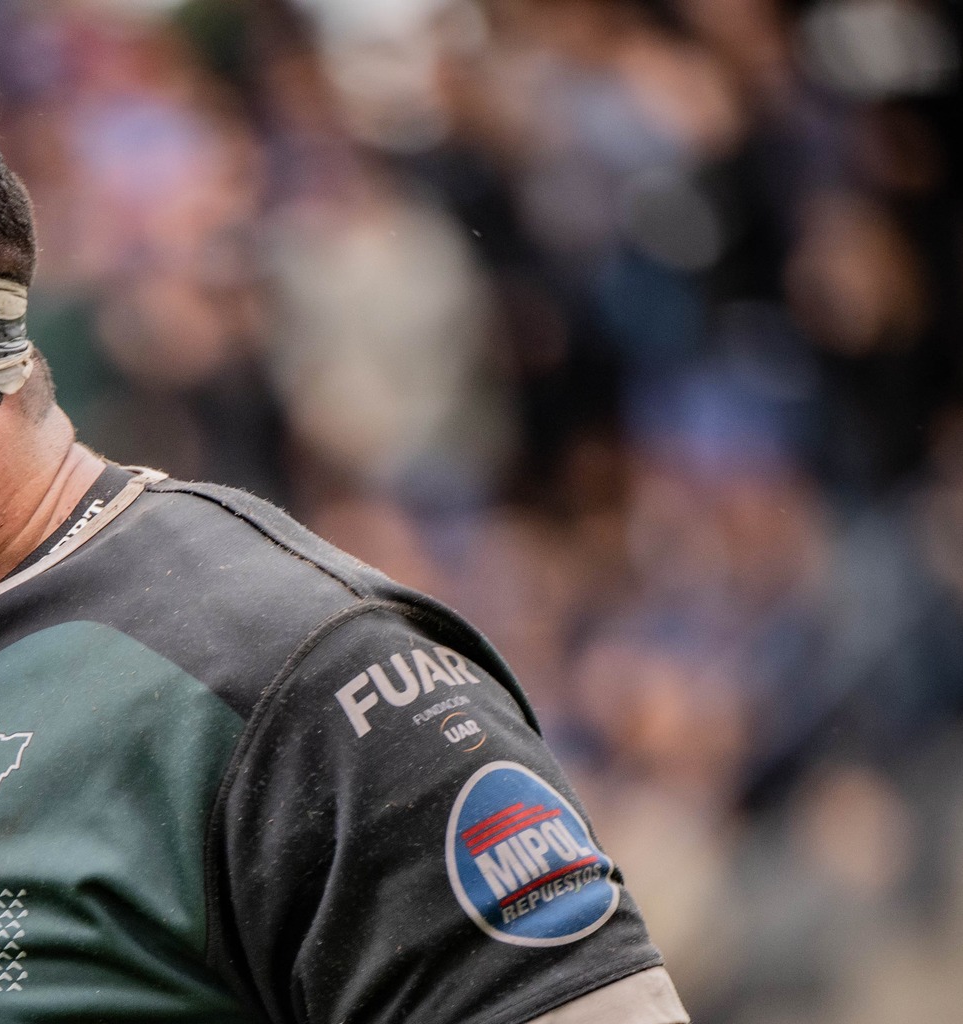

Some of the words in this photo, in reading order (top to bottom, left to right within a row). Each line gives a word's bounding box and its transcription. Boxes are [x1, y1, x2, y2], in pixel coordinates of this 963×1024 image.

[334, 646, 481, 738] FUAR
[443, 719, 482, 743] UAR
[474, 817, 593, 900] MIPOL
[500, 863, 603, 925] REPUESTOS
